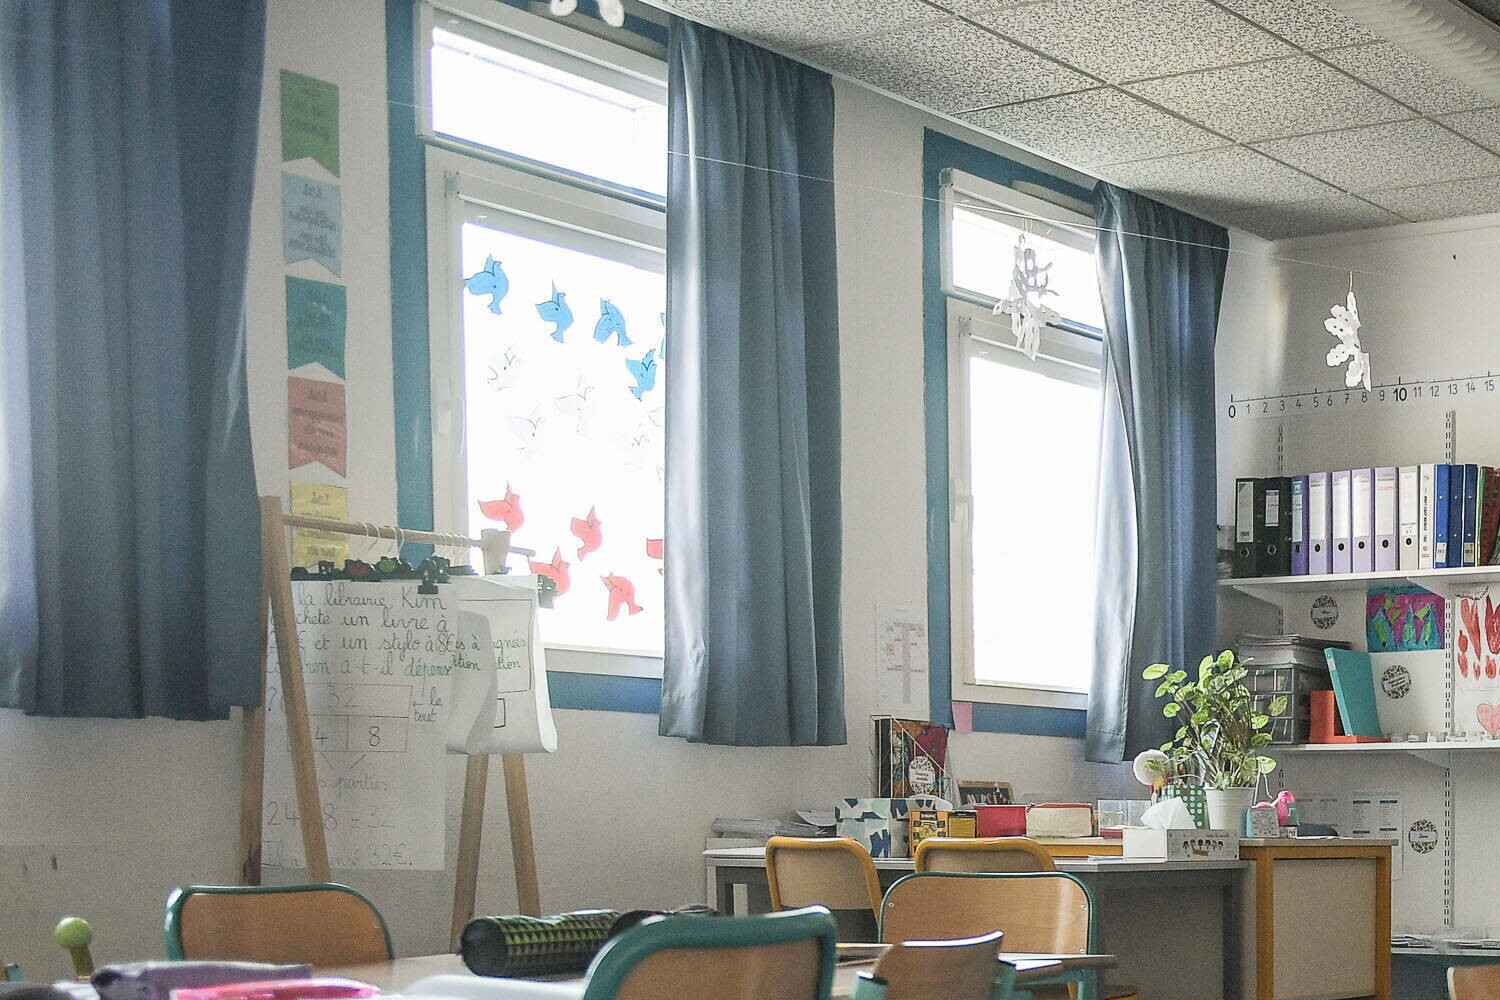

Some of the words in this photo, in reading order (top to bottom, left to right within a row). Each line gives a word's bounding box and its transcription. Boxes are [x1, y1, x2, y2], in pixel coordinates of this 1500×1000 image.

[1228, 405, 1236, 418] 0
[1246, 404, 1251, 414] 1
[1262, 402, 1268, 413] 2
[1280, 400, 1285, 411] 3
[1296, 398, 1302, 408] 4
[1313, 397, 1319, 408] 5
[1327, 396, 1333, 406] 6
[1344, 394, 1350, 404] 7
[1362, 392, 1368, 403] 8
[1379, 390, 1385, 401] 9
[1393, 388, 1408, 402] 10
[1412, 386, 1422, 398] 11
[1430, 386, 1440, 397] 12
[1448, 386, 1458, 395] 13
[1466, 382, 1476, 393] 14
[1484, 380, 1494, 392] 15
[402, 586, 447, 610] Kim
[343, 615, 370, 627] un
[381, 606, 430, 630] livre
[437, 615, 448, 632] à
[342, 637, 368, 650] un
[381, 630, 421, 661] stylo
[368, 726, 380, 746] 8
[324, 804, 338, 831] 8
